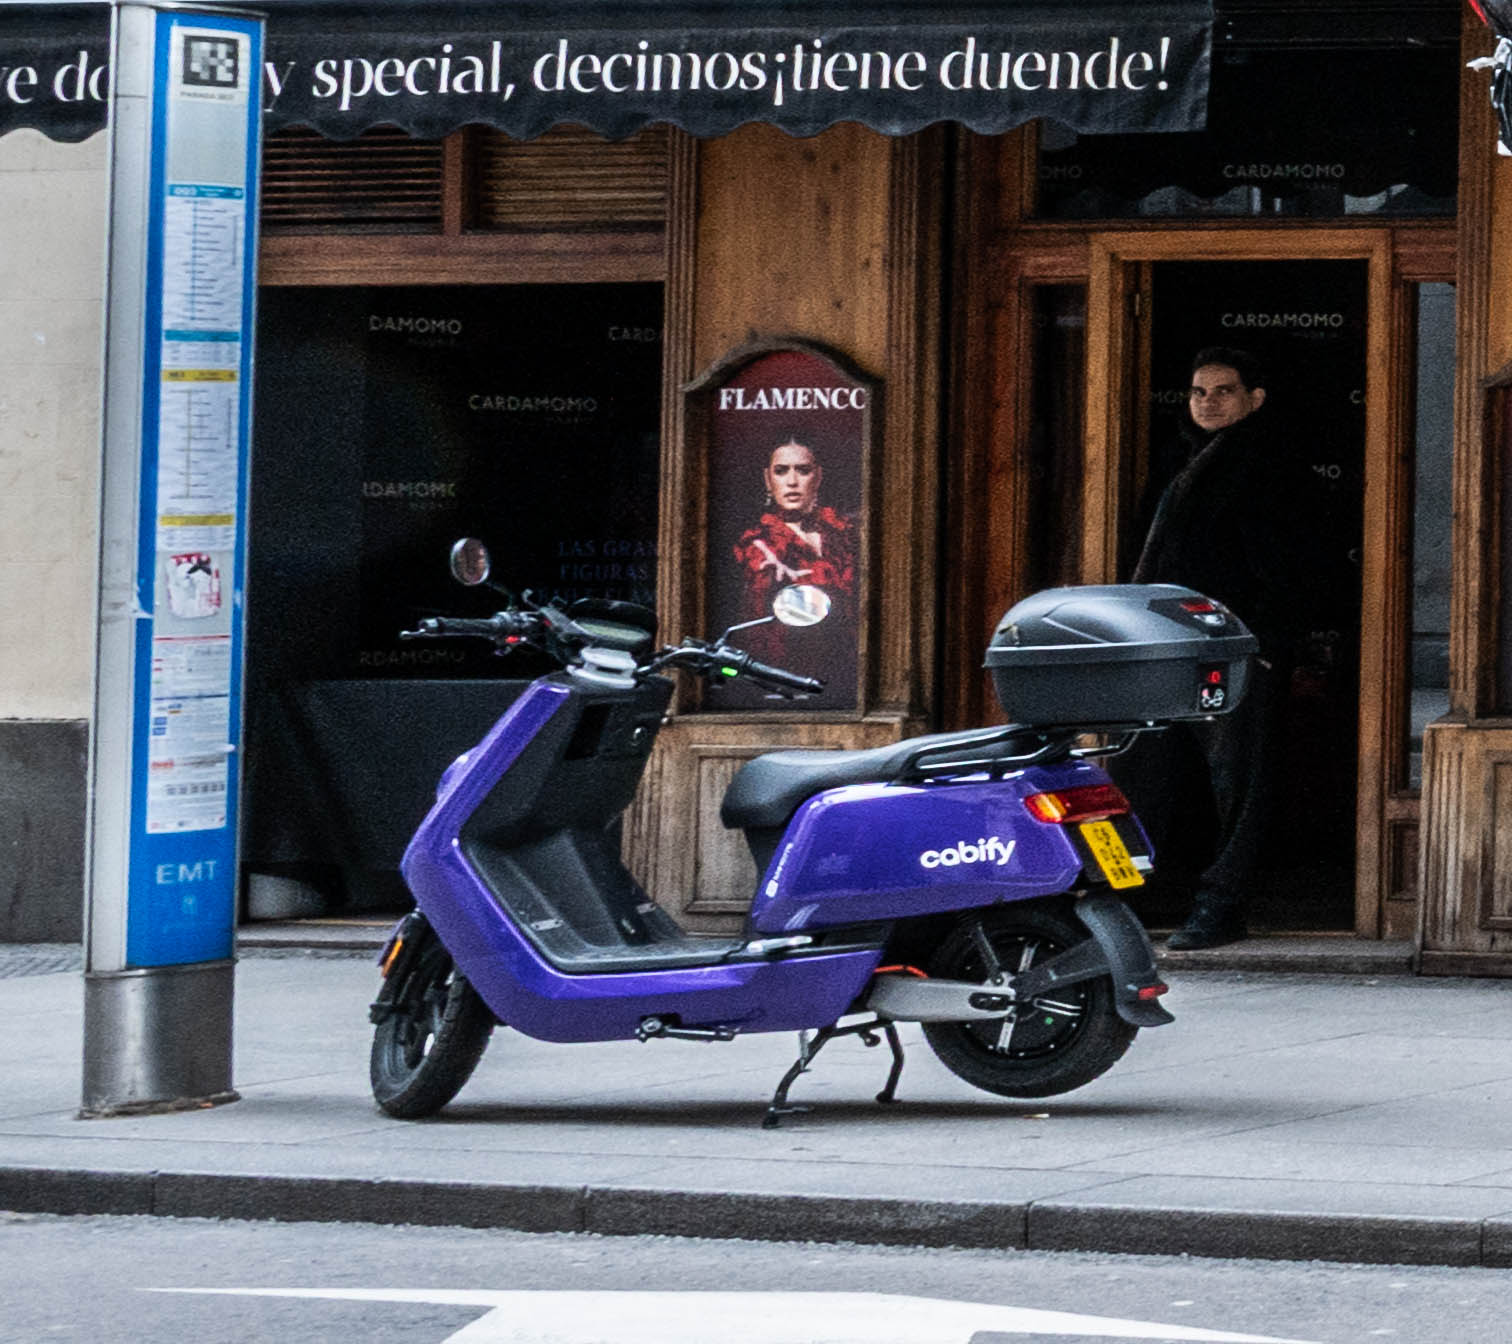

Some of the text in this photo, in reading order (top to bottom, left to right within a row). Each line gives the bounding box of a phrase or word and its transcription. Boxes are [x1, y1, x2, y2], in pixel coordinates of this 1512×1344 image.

[311, 39, 516, 111] special,
[532, 38, 767, 97] decimos
[939, 36, 1171, 92] duende!
[1222, 163, 1345, 180] CARDAMOMO
[1220, 312, 1344, 328] CARDAMOMO
[918, 837, 1017, 871] cabify
[156, 860, 217, 886] EMT
